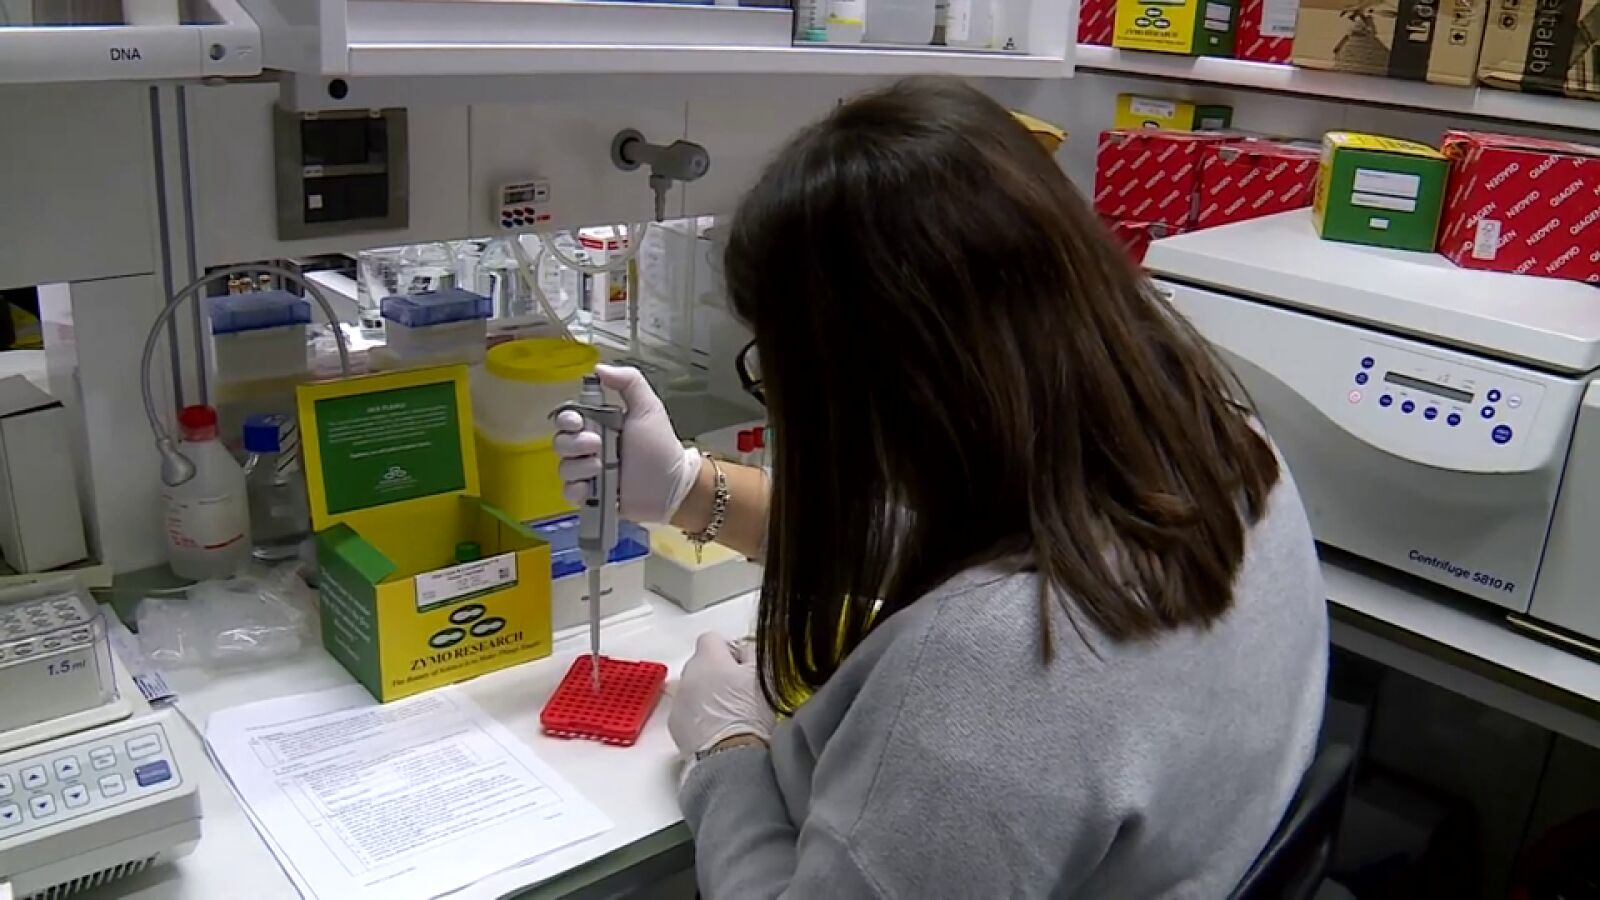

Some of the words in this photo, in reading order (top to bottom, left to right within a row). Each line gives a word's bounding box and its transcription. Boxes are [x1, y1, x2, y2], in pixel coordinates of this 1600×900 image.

[109, 47, 141, 61] DNA
[1550, 179, 1584, 207] QIAGEN
[1408, 549, 1471, 579] Centrifuge
[1472, 571, 1503, 589] 5810
[1503, 582, 1515, 593] R
[411, 652, 451, 671] ZYMO
[454, 631, 524, 658] RESEARCH
[47, 659, 71, 676] 1.5
